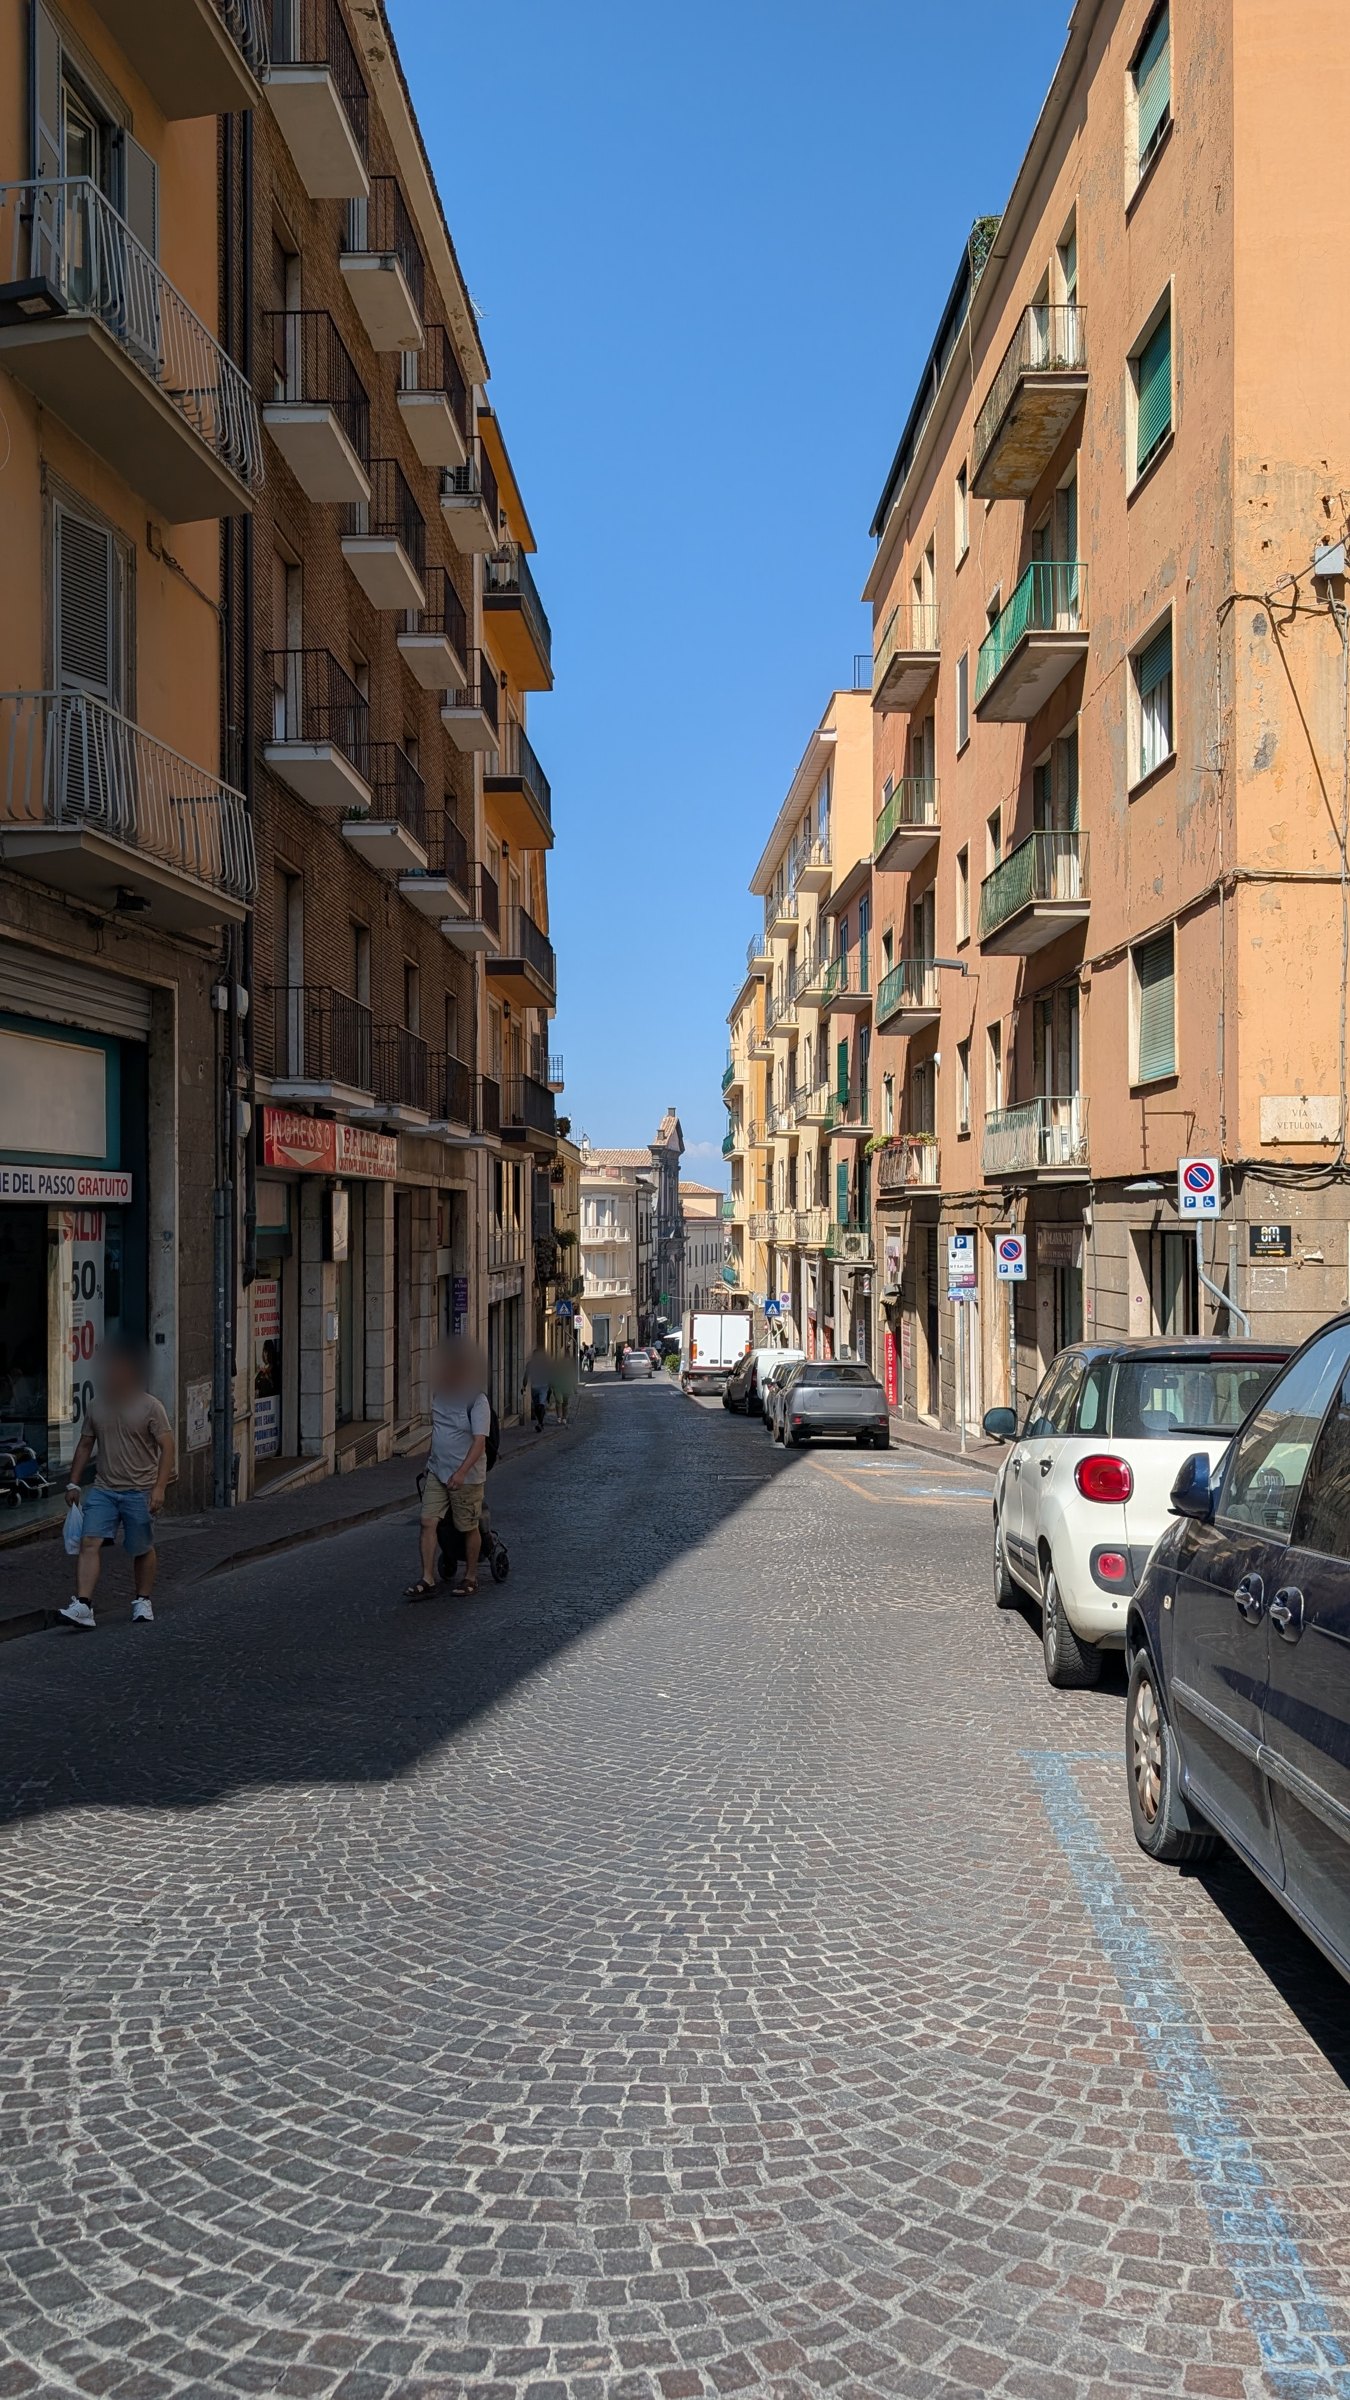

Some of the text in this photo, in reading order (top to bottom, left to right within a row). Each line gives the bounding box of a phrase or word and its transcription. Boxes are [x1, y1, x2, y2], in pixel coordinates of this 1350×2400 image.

[1292, 1109, 1308, 1117] VIA
[270, 1111, 331, 1151] INGRESSO
[1277, 1121, 1324, 1131] VETULONIA
[13, 1173, 35, 1194] DEL
[39, 1174, 75, 1196] PASSO
[78, 1176, 128, 1197] GRATUITO
[62, 1211, 103, 1241] SALDI
[1264, 1475, 1279, 1486] FIAT
